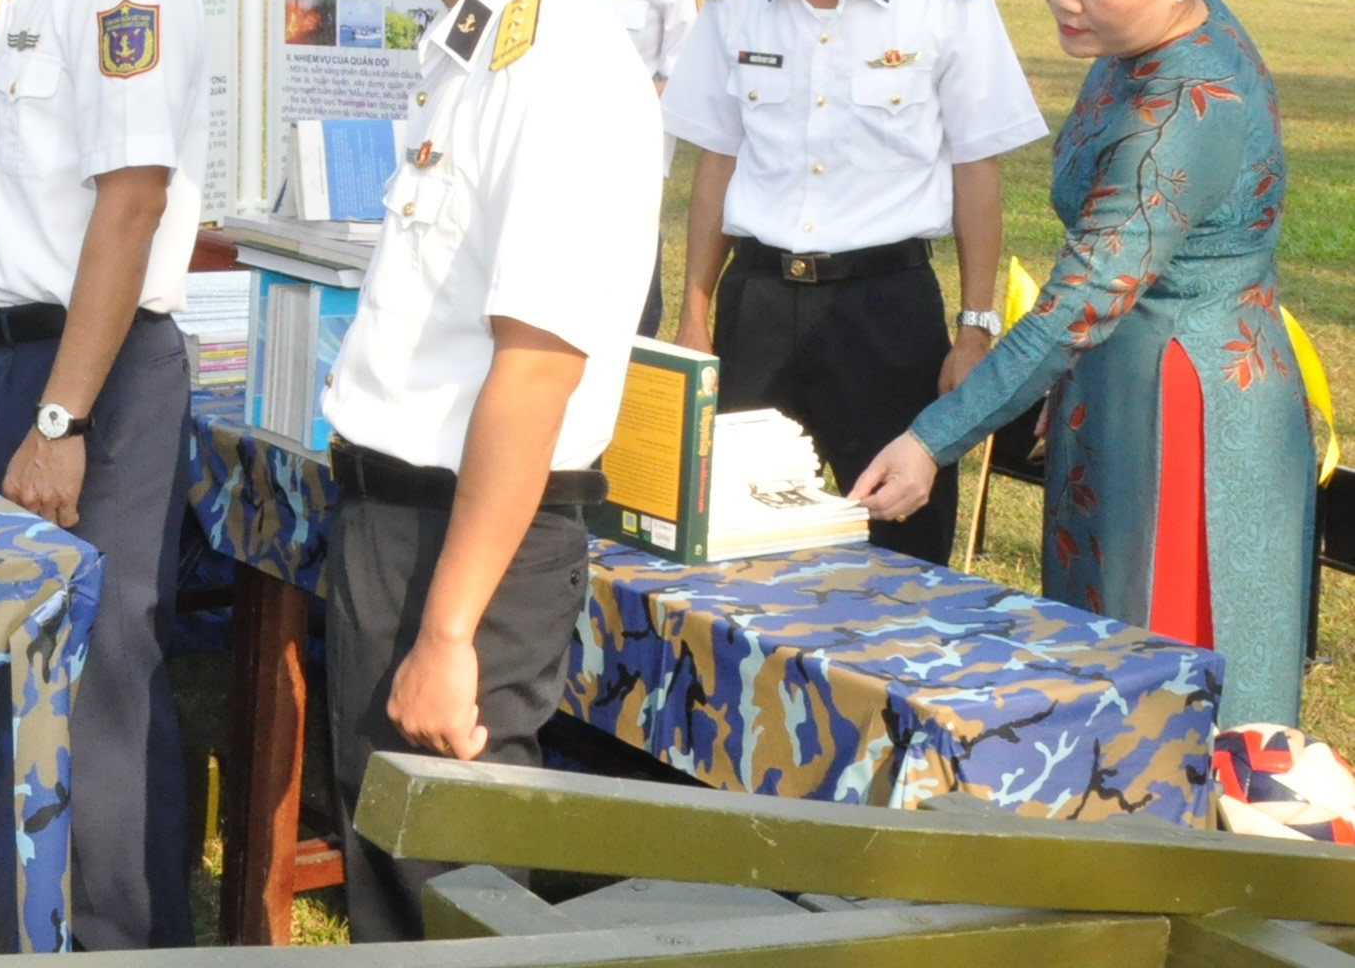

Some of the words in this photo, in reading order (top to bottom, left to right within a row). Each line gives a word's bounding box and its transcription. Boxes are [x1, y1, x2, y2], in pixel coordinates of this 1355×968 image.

[294, 54, 320, 63] NHIỆM
[320, 56, 332, 64] VỤ
[332, 55, 349, 64] CỦA
[350, 56, 374, 66] QUÂN
[375, 57, 390, 68] ĐỘI
